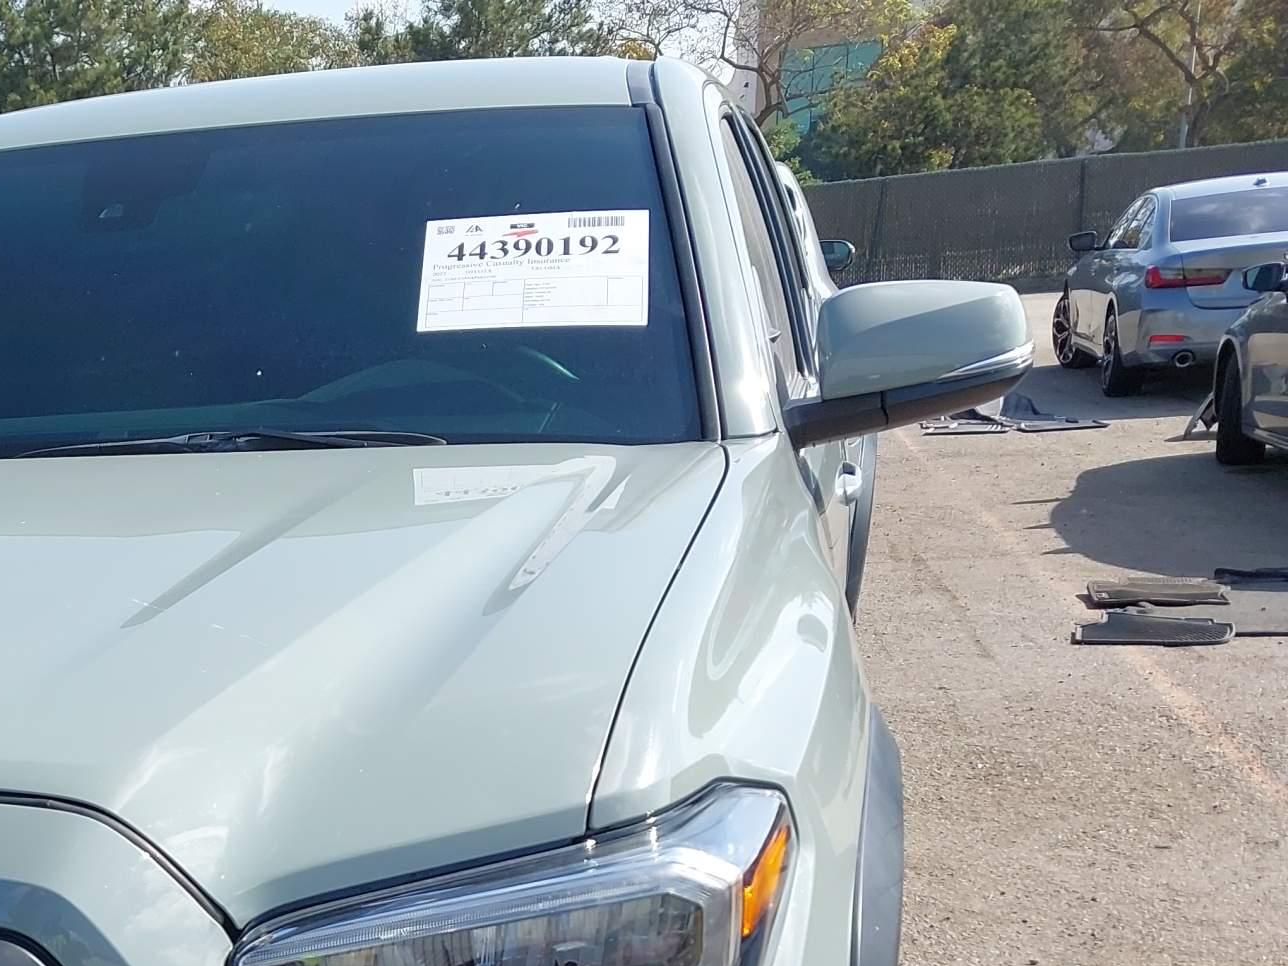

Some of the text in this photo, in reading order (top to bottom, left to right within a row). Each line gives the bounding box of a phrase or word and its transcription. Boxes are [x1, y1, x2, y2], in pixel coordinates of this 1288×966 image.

[447, 234, 621, 261] 44390192
[433, 257, 570, 271] Progressive Casualty Insurance
